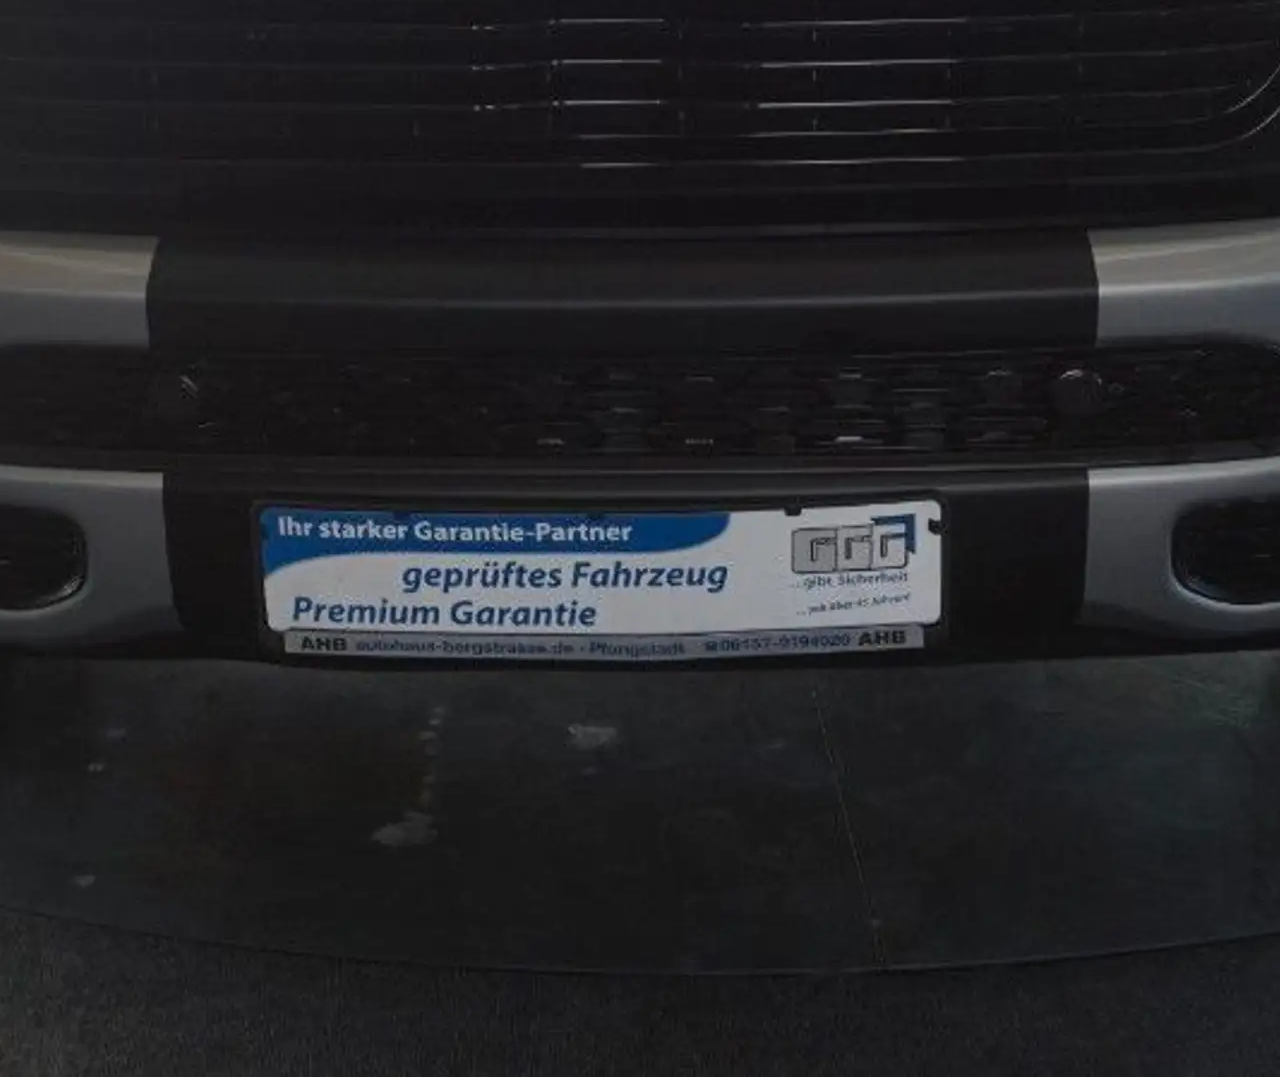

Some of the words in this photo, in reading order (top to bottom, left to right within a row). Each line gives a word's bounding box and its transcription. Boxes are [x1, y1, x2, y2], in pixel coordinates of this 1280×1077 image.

[277, 516, 312, 537] Ihr
[319, 518, 409, 540] starker
[414, 519, 633, 543] Garantie-Partner
[402, 560, 563, 594] geprüftes
[571, 560, 729, 593] Fahrzeug
[292, 596, 441, 625] Premium
[451, 598, 597, 627] Garantie
[300, 635, 347, 652] AHB
[857, 629, 906, 647] AHB
